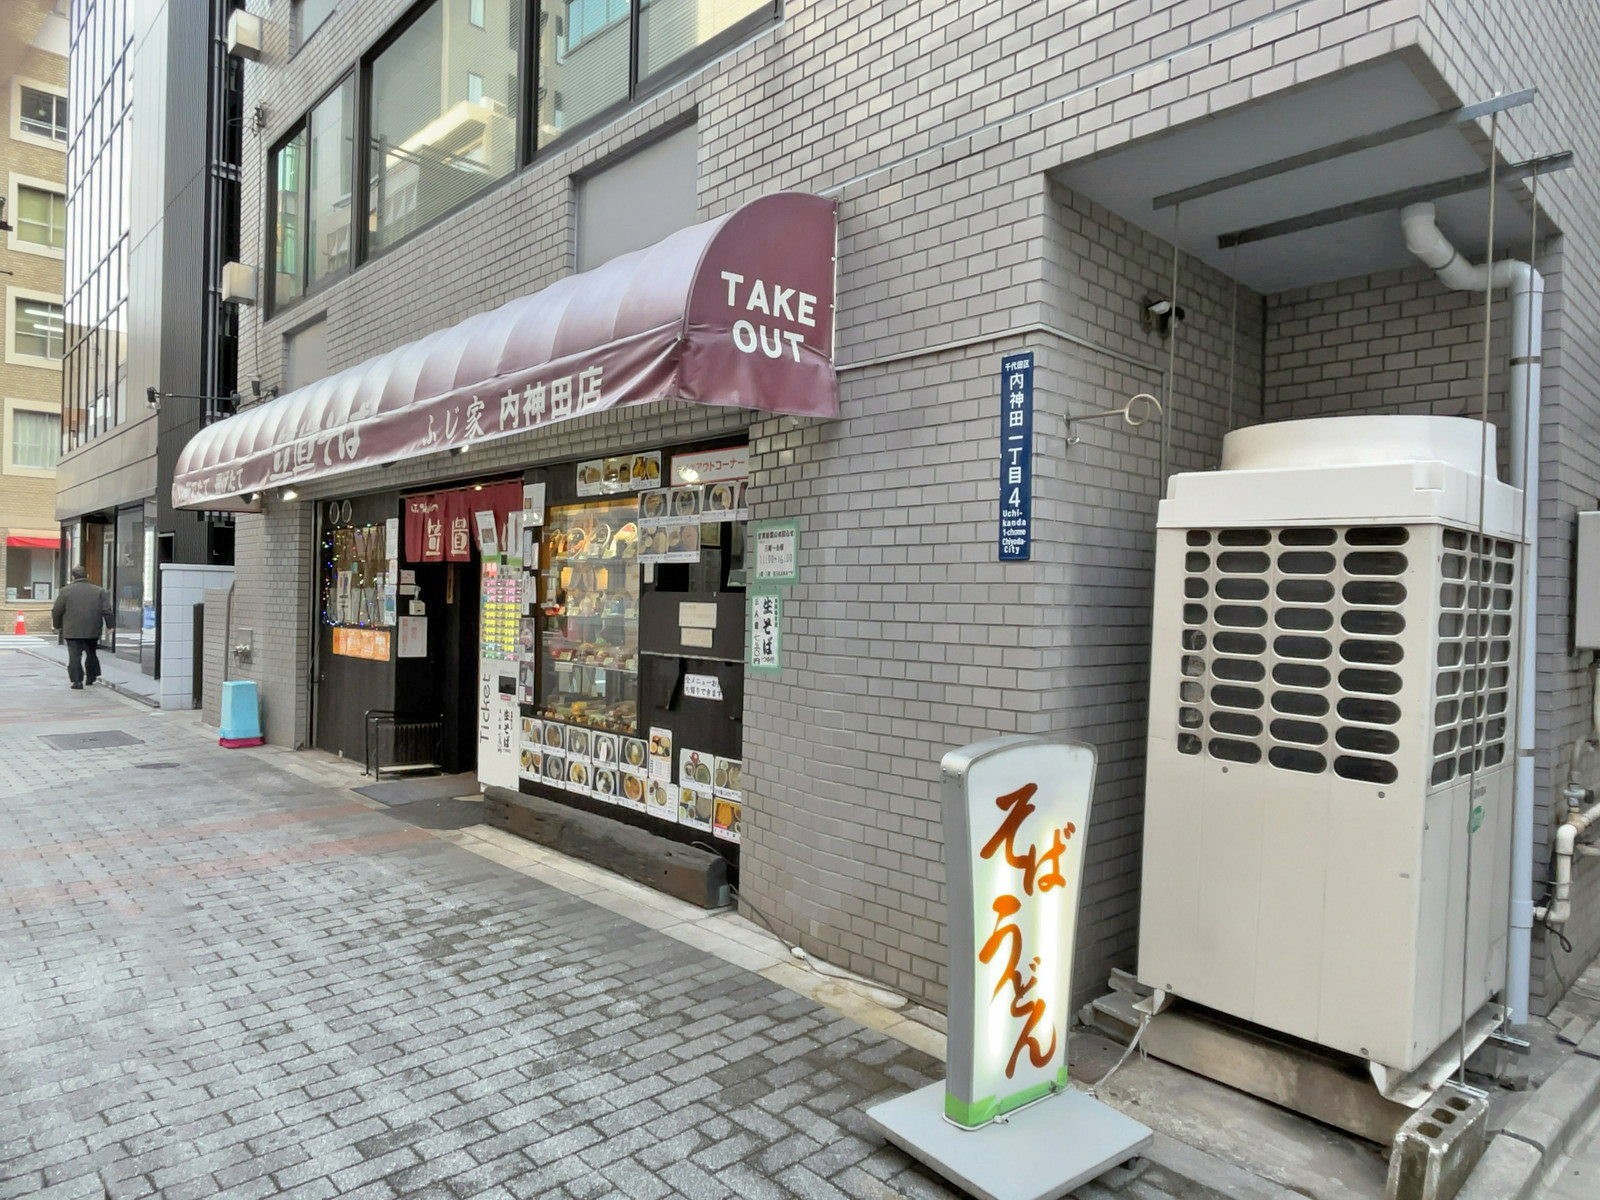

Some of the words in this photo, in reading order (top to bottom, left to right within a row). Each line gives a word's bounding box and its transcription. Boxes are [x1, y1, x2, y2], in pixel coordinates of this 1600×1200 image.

[721, 271, 817, 327] TAKE
[732, 319, 805, 363] OUT
[1004, 359, 1030, 371] 千代田区
[422, 395, 486, 447] ふじ家
[500, 365, 605, 431] 内神田店
[1008, 372, 1025, 508] 内神田一丁目4
[1002, 509, 1023, 518] Uchi-
[1002, 517, 1027, 527] kanda
[1003, 545, 1020, 555] City
[762, 596, 774, 656] 生そば
[480, 672, 491, 744] Ticket
[979, 782, 1077, 897] そば
[978, 894, 1057, 1080] うどん
